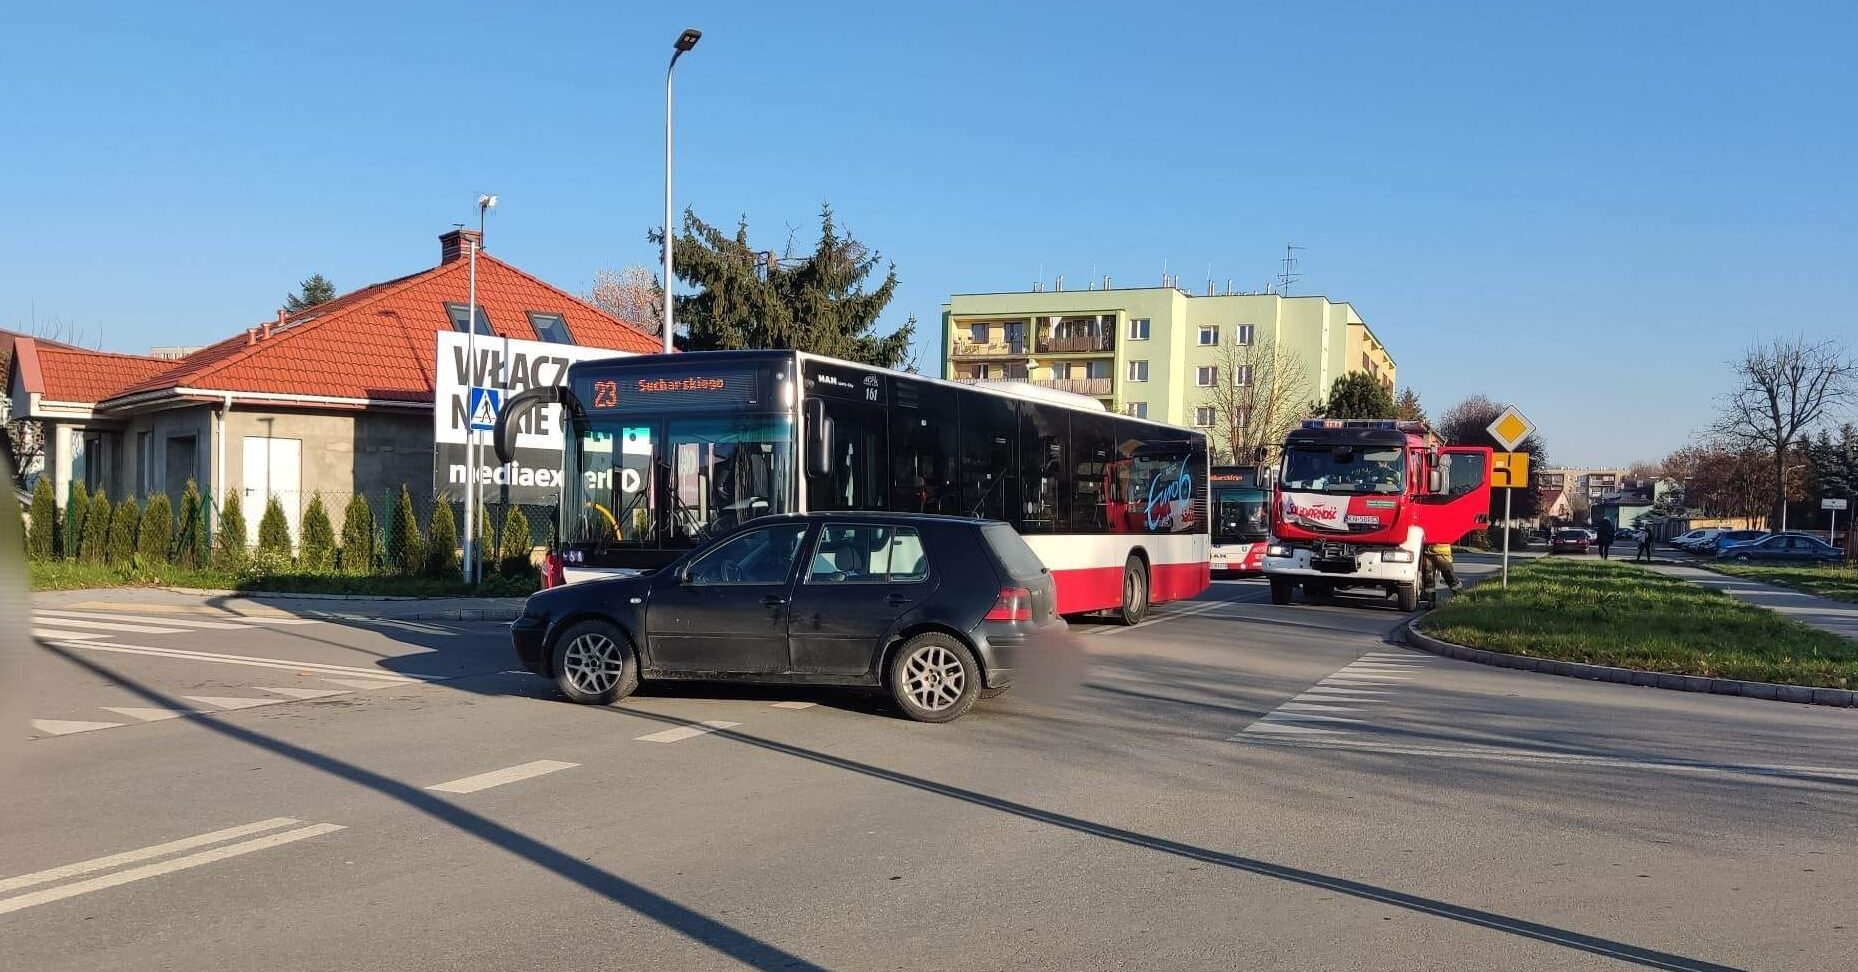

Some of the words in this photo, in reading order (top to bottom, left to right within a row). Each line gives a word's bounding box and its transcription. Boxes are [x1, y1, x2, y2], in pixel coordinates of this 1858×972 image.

[818, 374, 838, 385] MAN
[594, 381, 616, 408] 23
[639, 378, 724, 392] Sucharskiego
[865, 388, 878, 402] 161
